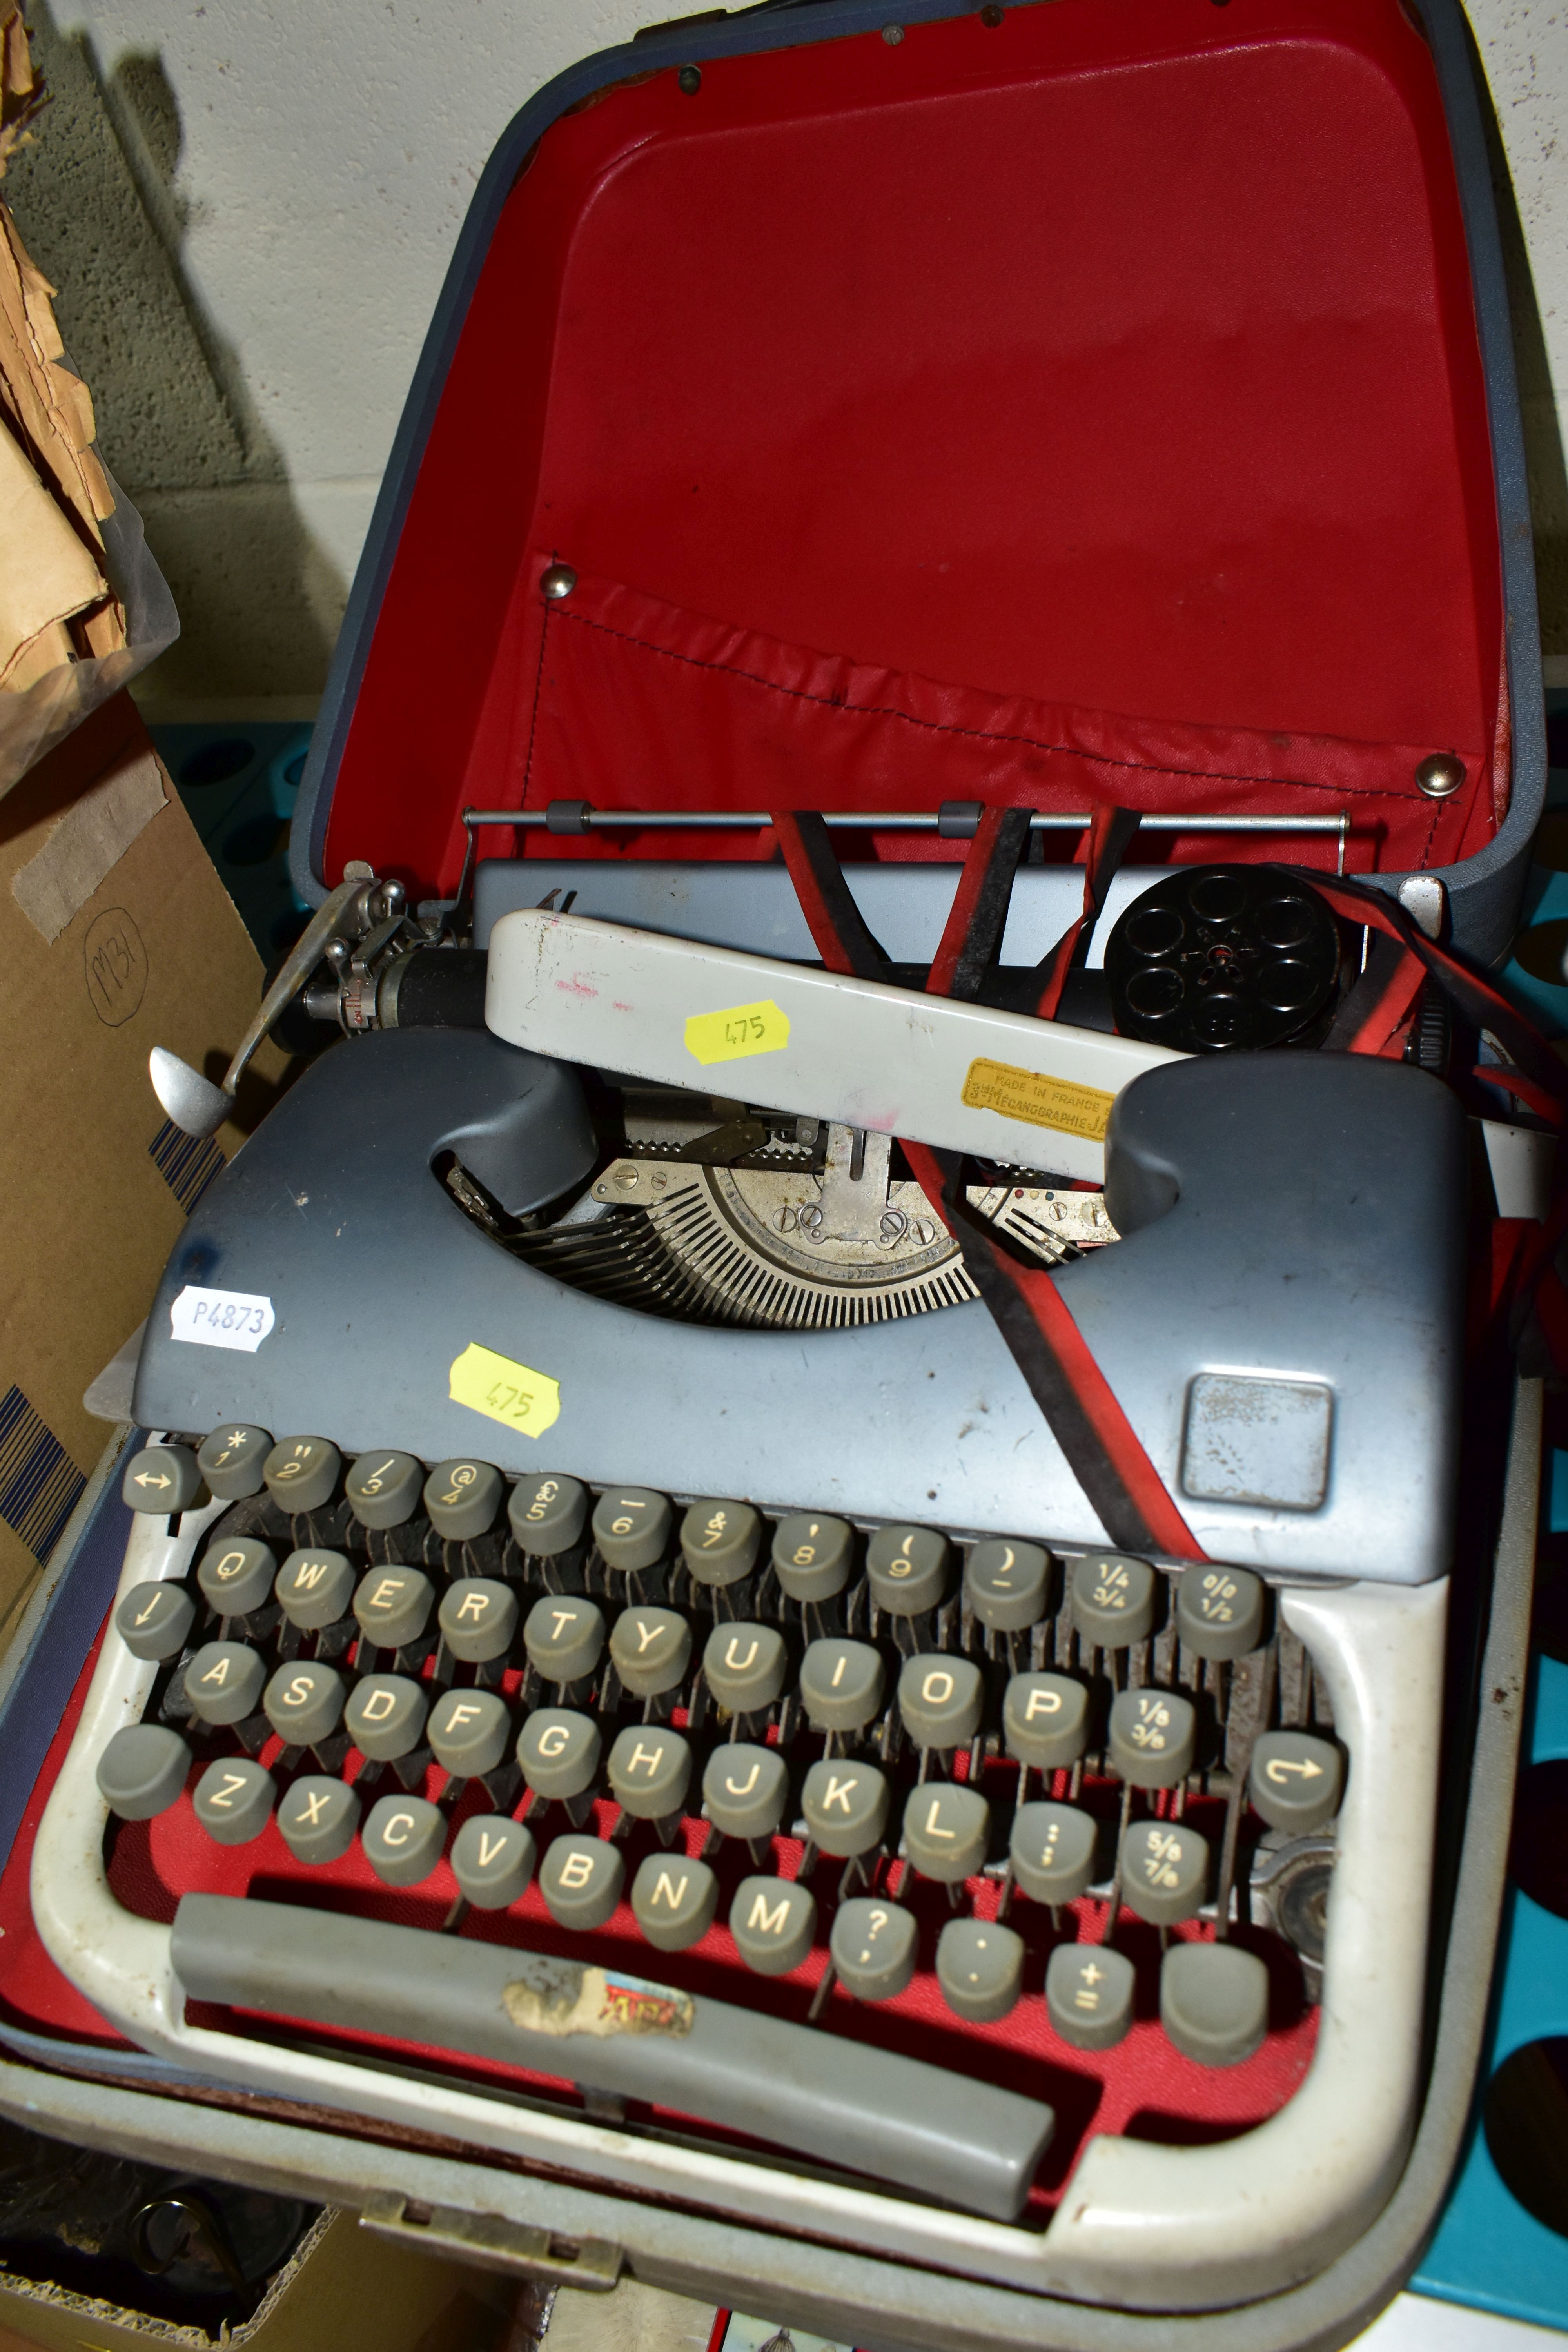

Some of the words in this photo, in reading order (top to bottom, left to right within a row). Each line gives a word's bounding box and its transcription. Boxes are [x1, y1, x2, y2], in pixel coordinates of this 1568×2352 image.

[726, 1016, 765, 1044] 475
[995, 1075, 1027, 1092] MADE
[1033, 1086, 1046, 1098] IN
[1051, 1092, 1100, 1112] FRANCE
[1087, 1116, 1106, 1133] JA
[193, 1301, 265, 1334] P4873
[486, 1382, 534, 1417] 475
[216, 1452, 230, 1465] 1
[277, 1463, 301, 1477] 2
[362, 1476, 382, 1494] 3
[451, 1465, 476, 1488] @
[442, 1488, 462, 1504] 4
[536, 1481, 558, 1501] £
[527, 1503, 546, 1519] 5
[612, 1517, 633, 1533] 6
[708, 1512, 726, 1530] &
[704, 1530, 722, 1546] 7
[217, 1552, 245, 1579] Q
[794, 1546, 815, 1564] 8
[889, 1559, 911, 1577] 9
[295, 1563, 327, 1588] W
[370, 1579, 404, 1607] E
[458, 1593, 489, 1621] R
[552, 1612, 576, 1639] T
[637, 1622, 665, 1651] Y
[726, 1638, 758, 1668] U
[202, 1658, 229, 1684] A
[283, 1677, 314, 1704] S
[923, 1672, 953, 1702] O
[363, 1690, 395, 1719] D
[446, 1704, 481, 1732] F
[1026, 1690, 1061, 1720] P
[539, 1726, 569, 1756] G
[628, 1743, 663, 1775] H
[210, 1774, 246, 1806] Z
[726, 1764, 760, 1794] J
[297, 1792, 330, 1824] X
[824, 1777, 857, 1812] K
[383, 1814, 414, 1844] C
[926, 1800, 954, 1837] L
[479, 1833, 506, 1866] V
[560, 1853, 593, 1887] B
[652, 1873, 688, 1908] N
[748, 1895, 790, 1933] M
[869, 1910, 887, 1939] ?
